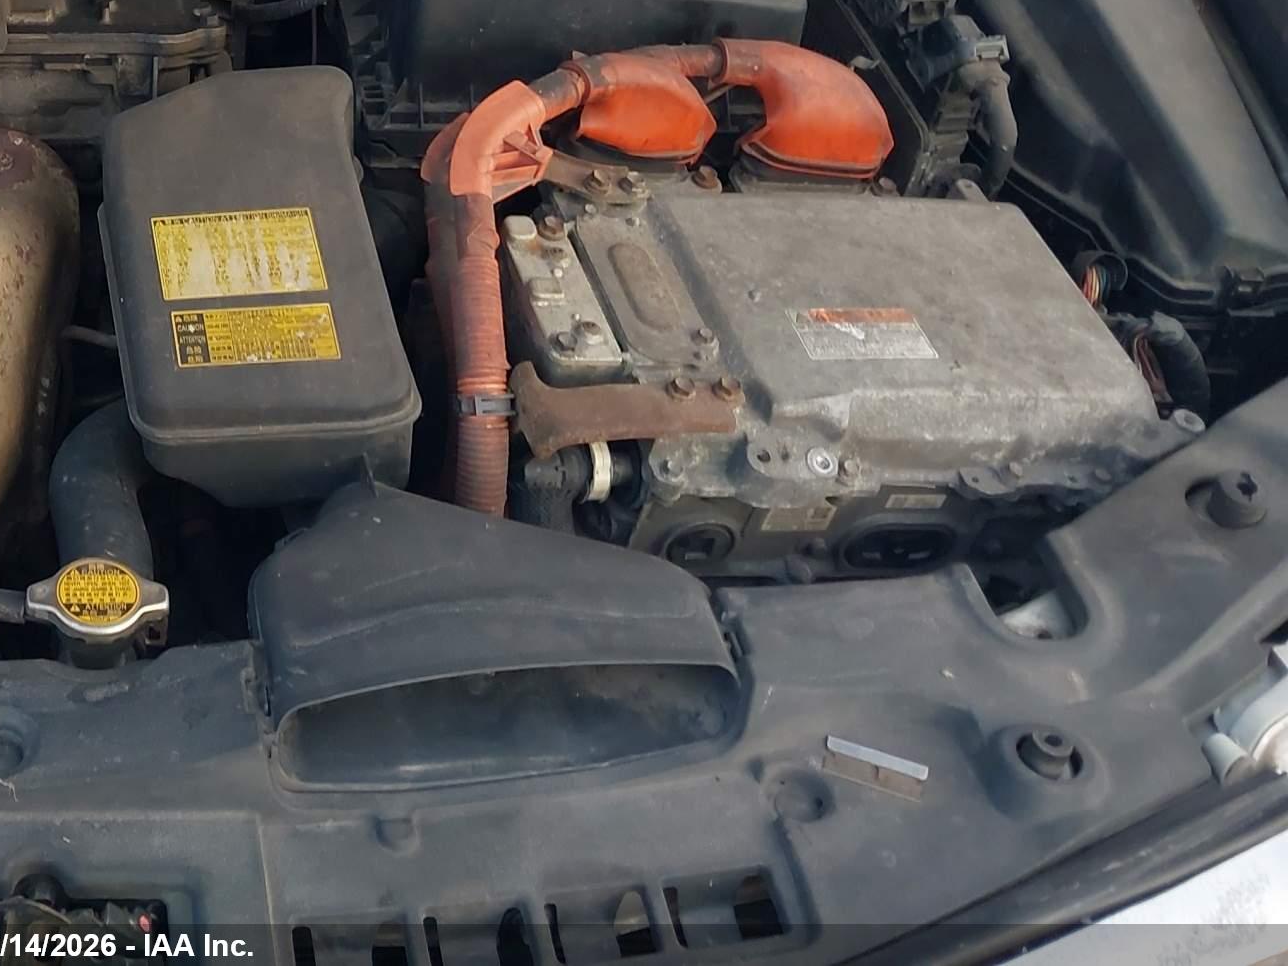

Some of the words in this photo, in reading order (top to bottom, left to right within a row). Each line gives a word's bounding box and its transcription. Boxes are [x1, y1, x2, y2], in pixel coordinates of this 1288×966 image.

[177, 323, 204, 332] CAUION
[179, 335, 206, 344] ATTENTION
[85, 603, 127, 611] ATTENTION
